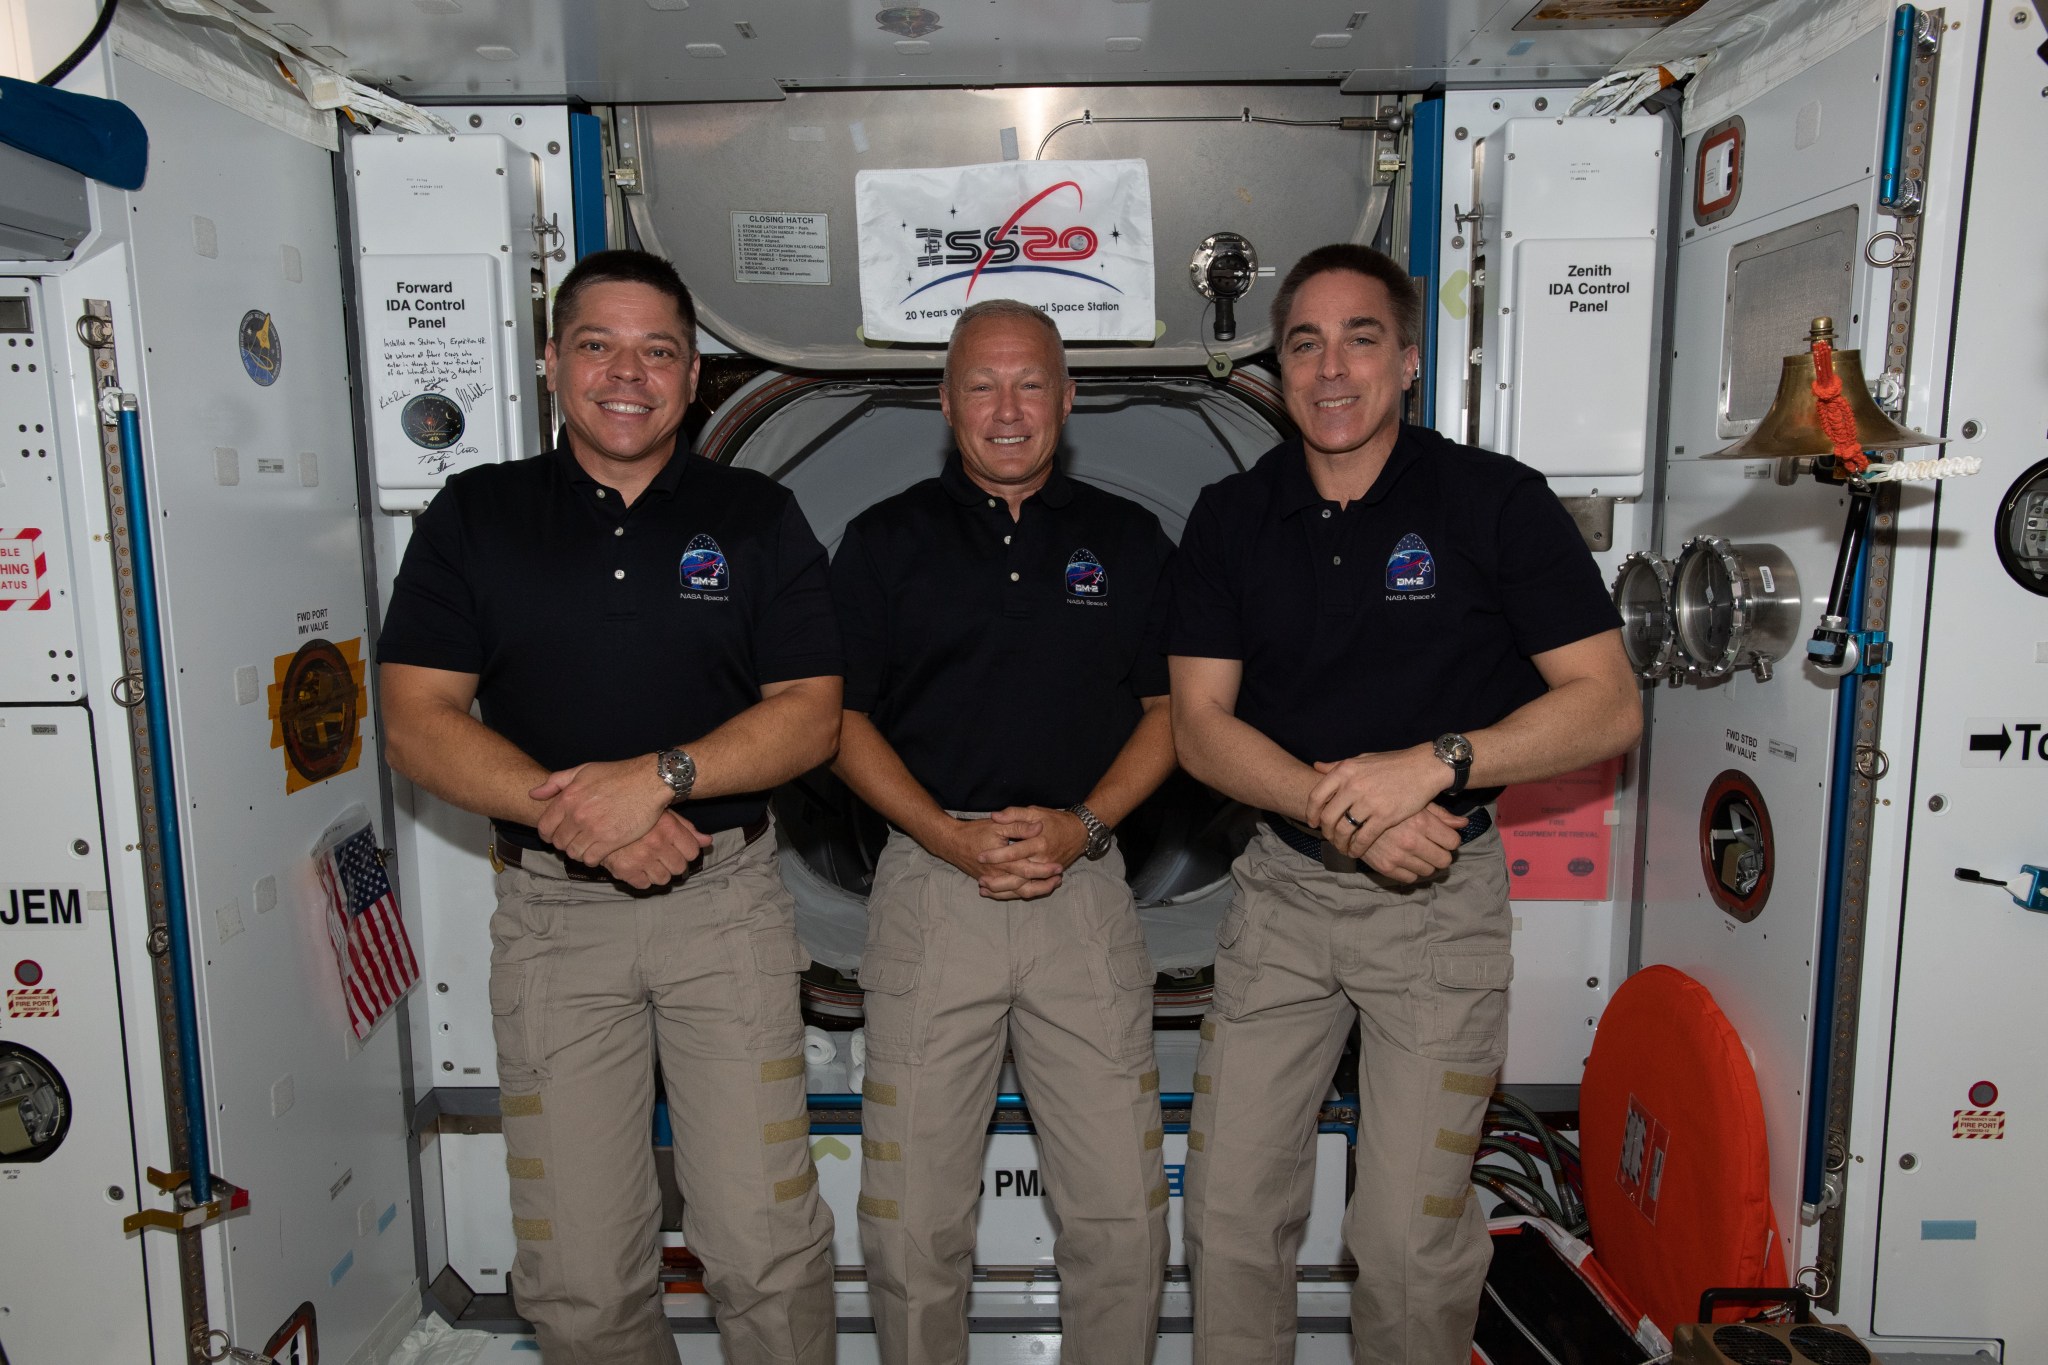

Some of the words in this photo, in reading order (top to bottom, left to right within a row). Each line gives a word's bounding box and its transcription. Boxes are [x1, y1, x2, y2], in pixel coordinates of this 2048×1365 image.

[749, 215, 784, 223] CLOSING
[1568, 264, 1611, 277] Zenith
[397, 282, 452, 293] Forward
[1549, 283, 1574, 295] IDA
[1578, 282, 1630, 294] Control
[386, 300, 411, 311] IDA
[415, 299, 465, 311] Control
[905, 311, 917, 320] 20
[920, 310, 948, 319] Years
[951, 308, 963, 316] on
[1051, 302, 1084, 313] Space
[1087, 301, 1119, 311] Station
[1570, 300, 1608, 312] Panel
[408, 317, 446, 328] Panel
[691, 576, 718, 586] DM-2
[1396, 577, 1424, 586] DM-2
[1075, 584, 1098, 592] DM-2
[297, 611, 310, 622] FWD
[312, 608, 328, 619] PORT
[298, 624, 309, 635] IMV
[310, 621, 329, 632] VALVE
[1726, 729, 1740, 741] FWD
[1740, 734, 1758, 748] STBD
[1725, 742, 1736, 753] IMV
[1737, 746, 1756, 761] VALVE
[0, 889, 82, 925] JEM
[995, 1170, 1046, 1197] PM
